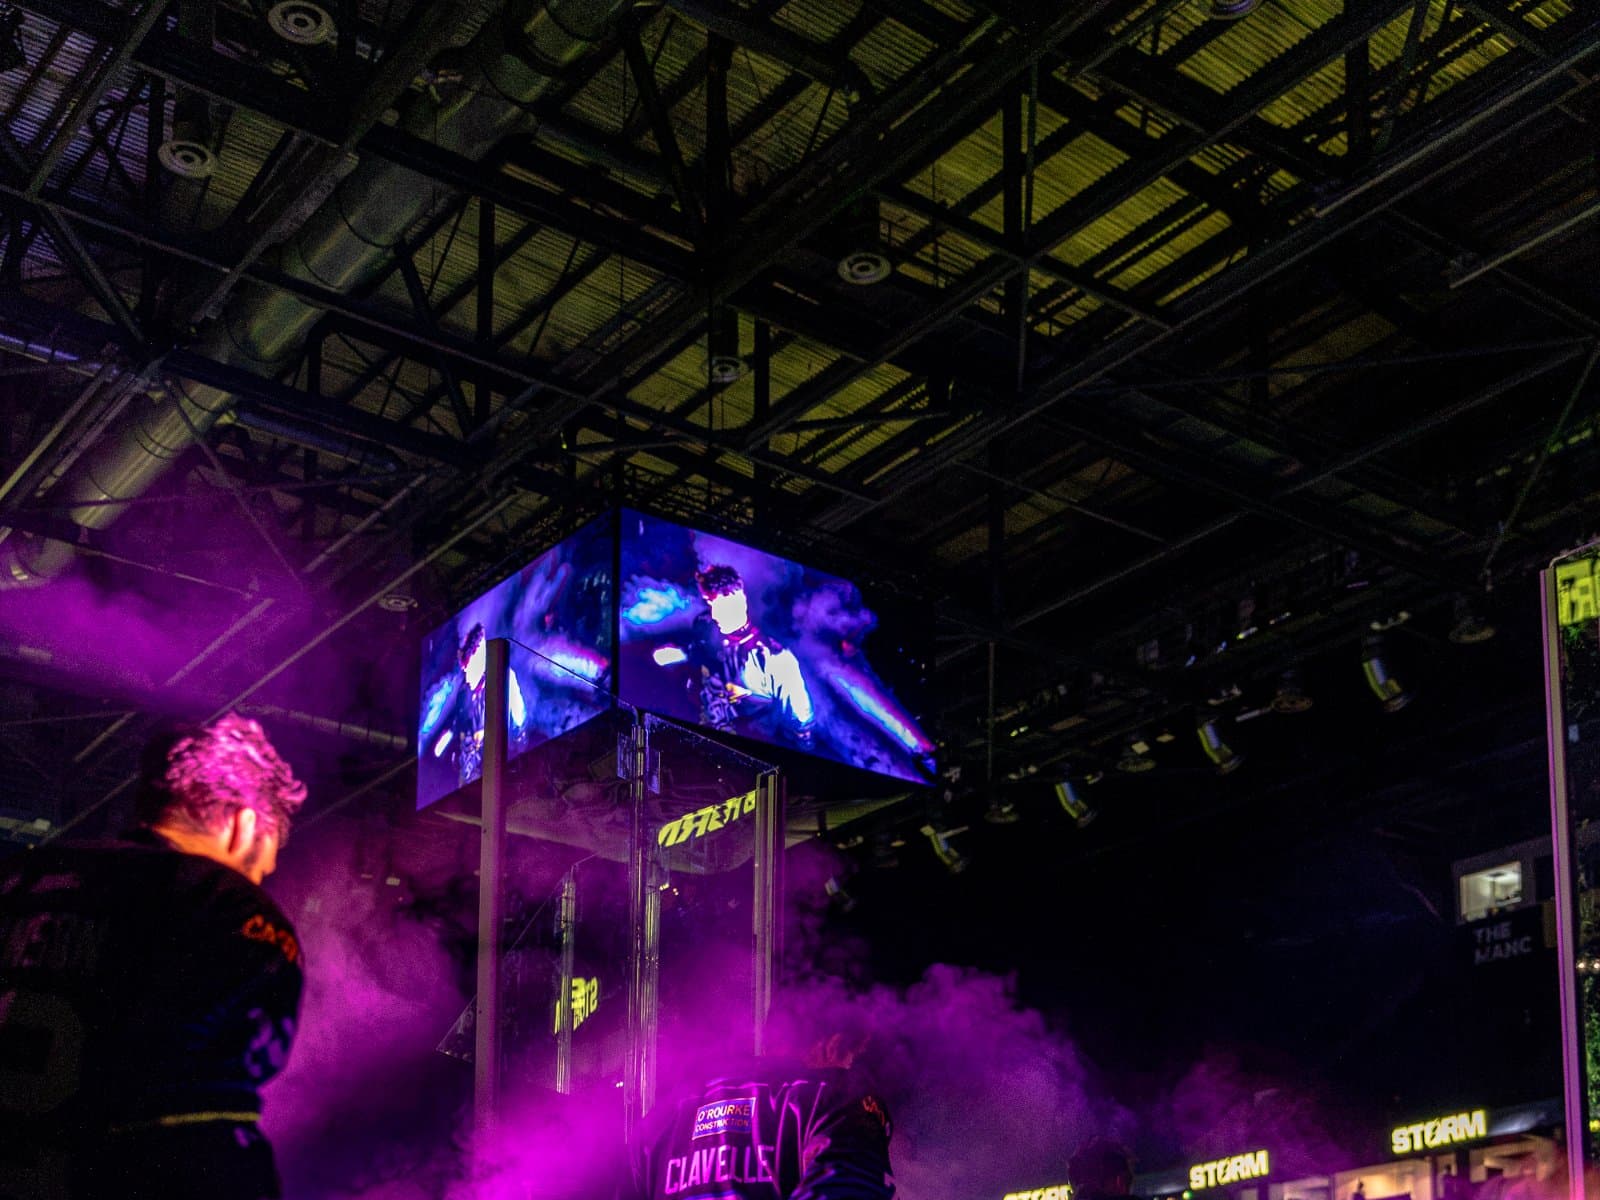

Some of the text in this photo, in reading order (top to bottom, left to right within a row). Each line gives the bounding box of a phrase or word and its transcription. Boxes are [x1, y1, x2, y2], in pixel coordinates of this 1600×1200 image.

[697, 1104, 750, 1123] O'ROURKE
[1391, 1110, 1486, 1154] STORM
[665, 1144, 775, 1195] CLAVELLE
[1190, 1150, 1269, 1190] STORM
